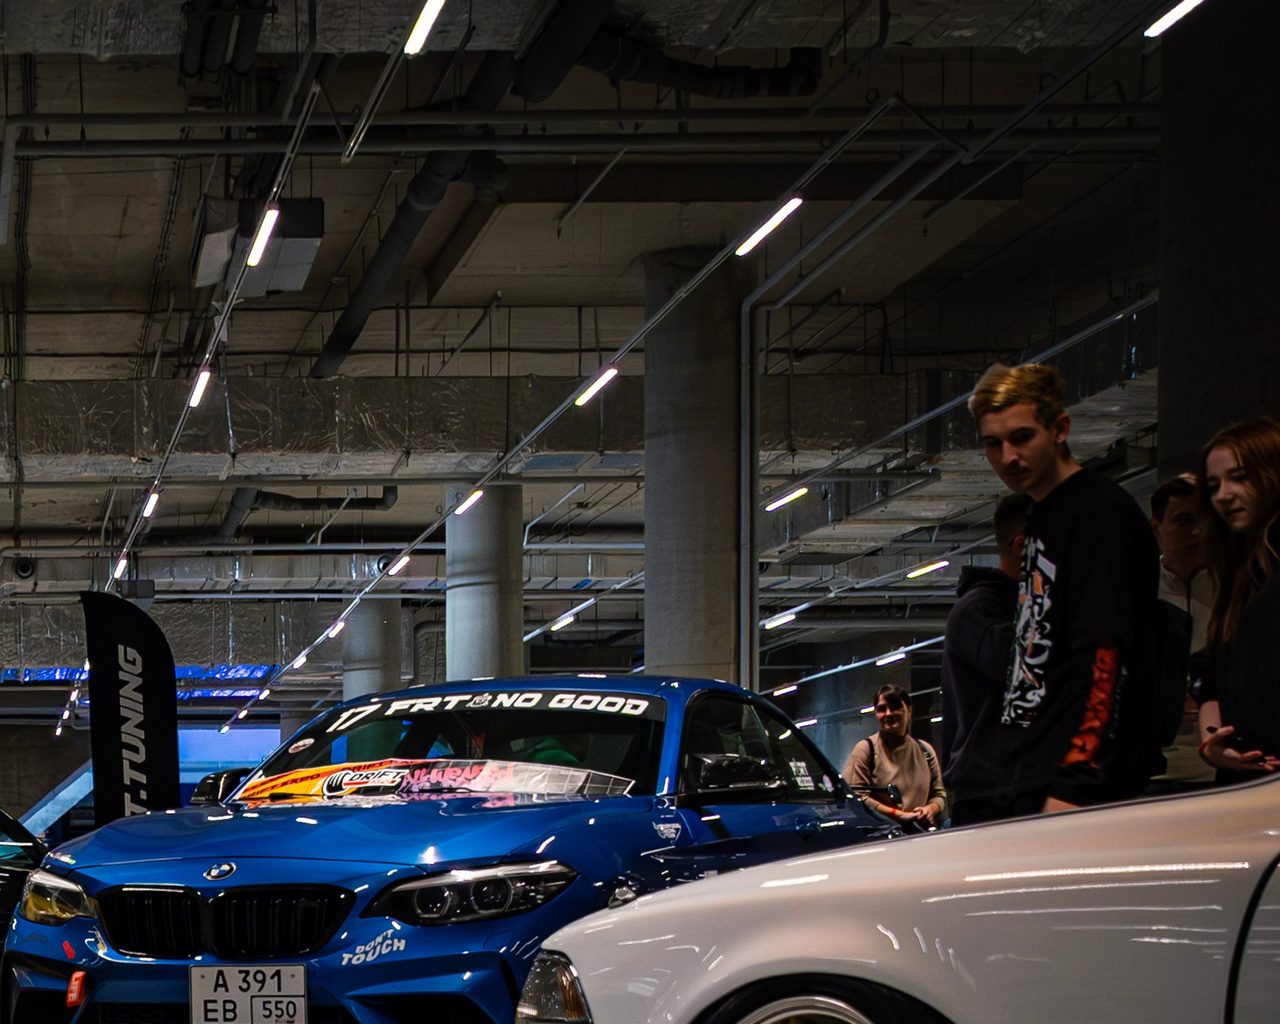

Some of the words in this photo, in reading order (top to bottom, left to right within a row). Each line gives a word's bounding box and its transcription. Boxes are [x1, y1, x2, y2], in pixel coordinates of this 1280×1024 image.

[384, 694, 472, 716] FRT
[494, 693, 544, 709] NO
[547, 693, 650, 715] GOOD
[326, 703, 381, 733] 17
[349, 770, 406, 782] DRIFT
[341, 938, 406, 966] TOUCH
[355, 929, 395, 954] DON'T
[213, 969, 229, 993] A
[238, 969, 282, 993] 391
[203, 999, 238, 1022] EB
[262, 1001, 297, 1019] 550
